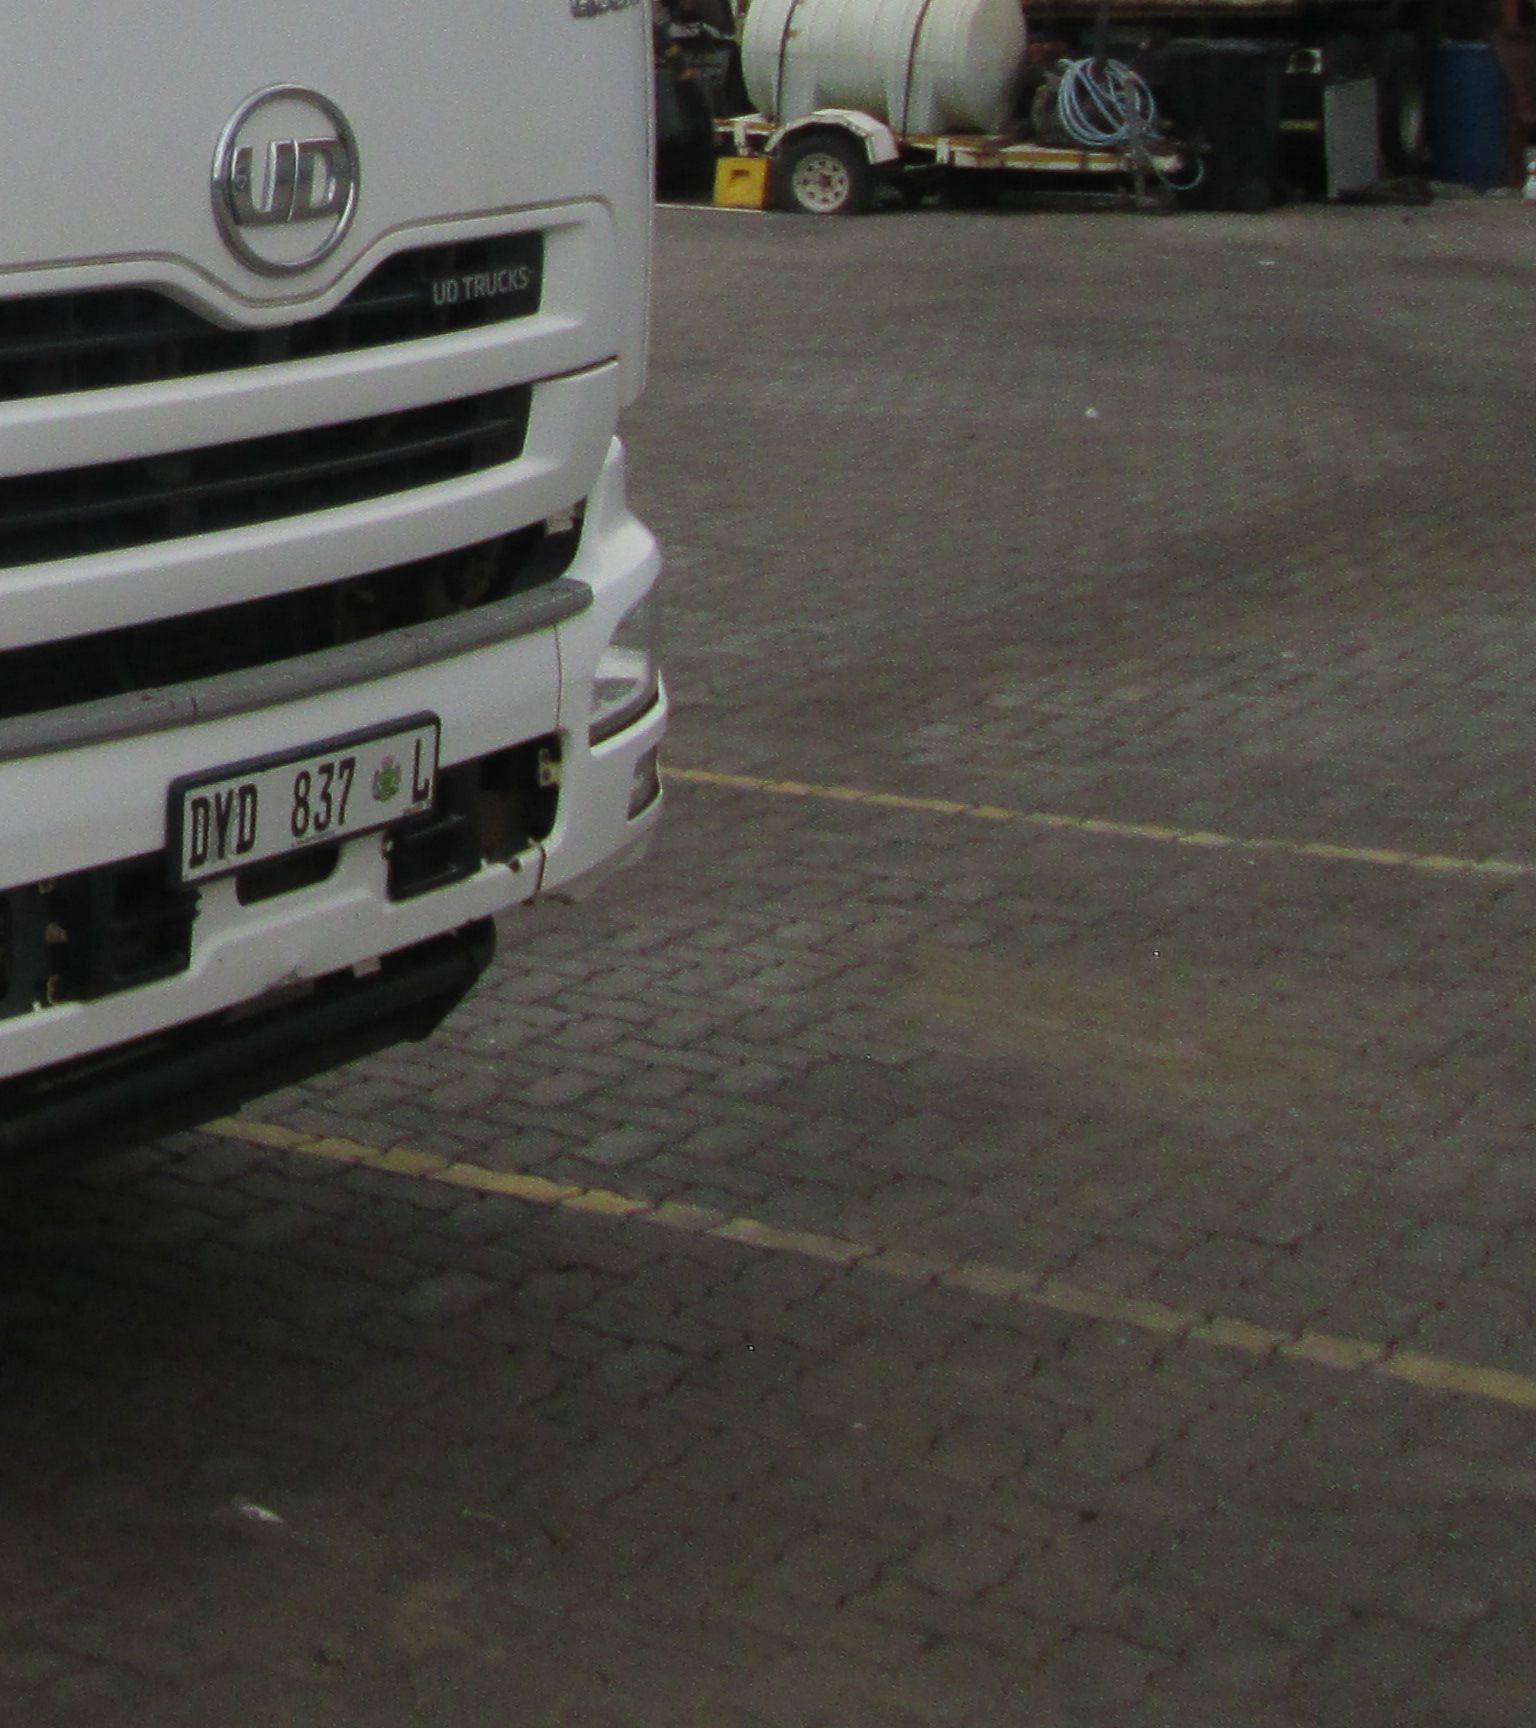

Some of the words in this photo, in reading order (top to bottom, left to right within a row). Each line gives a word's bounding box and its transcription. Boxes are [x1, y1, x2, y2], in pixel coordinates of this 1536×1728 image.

[231, 136, 344, 226] UD
[433, 281, 459, 306] UD
[462, 267, 529, 300] TRUCKS
[189, 783, 258, 869] DYD
[291, 756, 357, 837] 837
[412, 738, 430, 803] L
